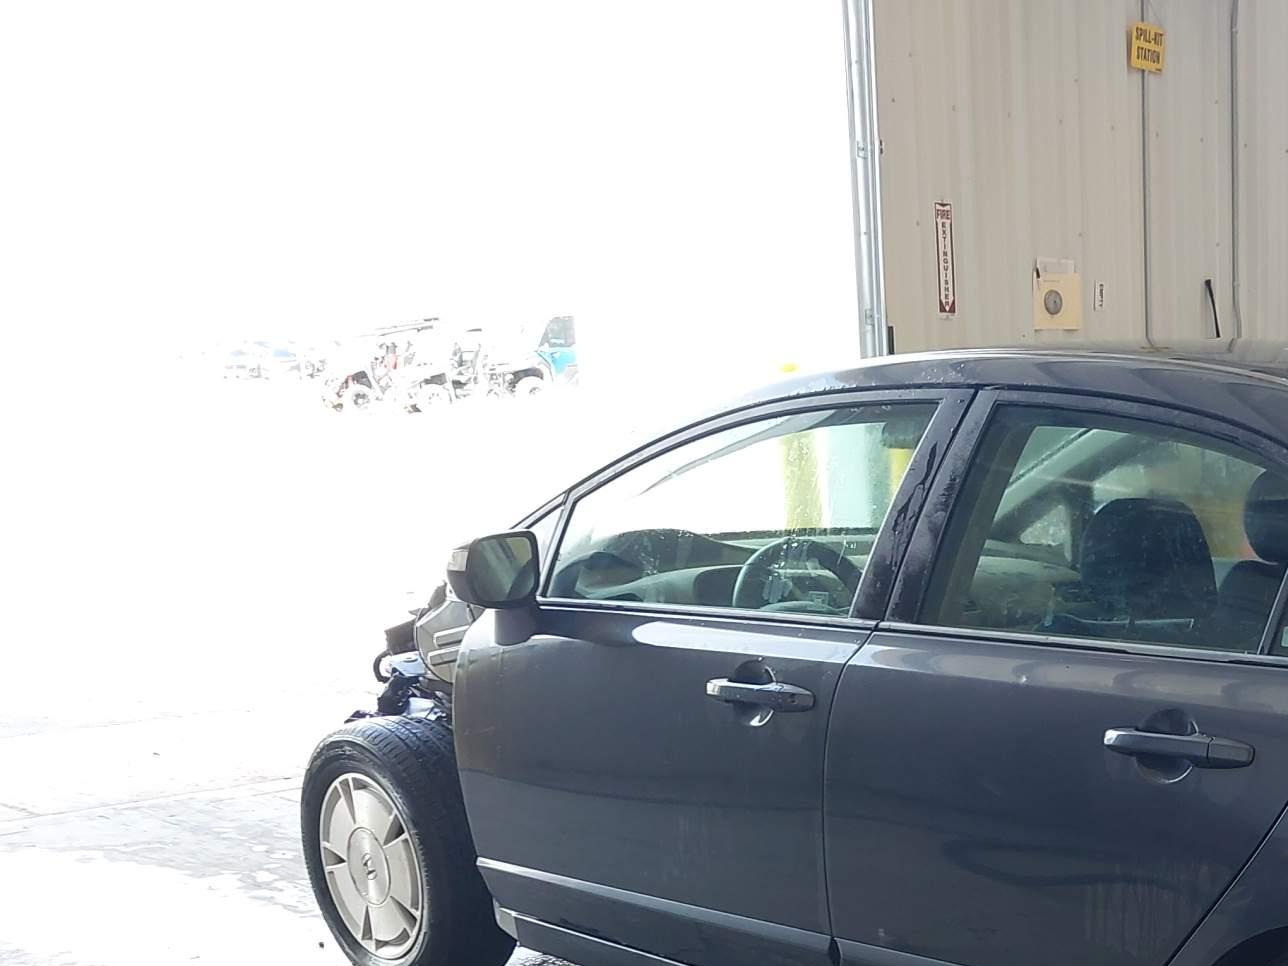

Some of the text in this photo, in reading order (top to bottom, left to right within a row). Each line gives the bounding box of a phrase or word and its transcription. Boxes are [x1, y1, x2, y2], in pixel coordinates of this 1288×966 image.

[1135, 26, 1164, 47] SPILL-KIT
[1136, 46, 1161, 65] STATION
[936, 209, 951, 220] FIRE
[941, 221, 950, 307] EXTINGUISHER
